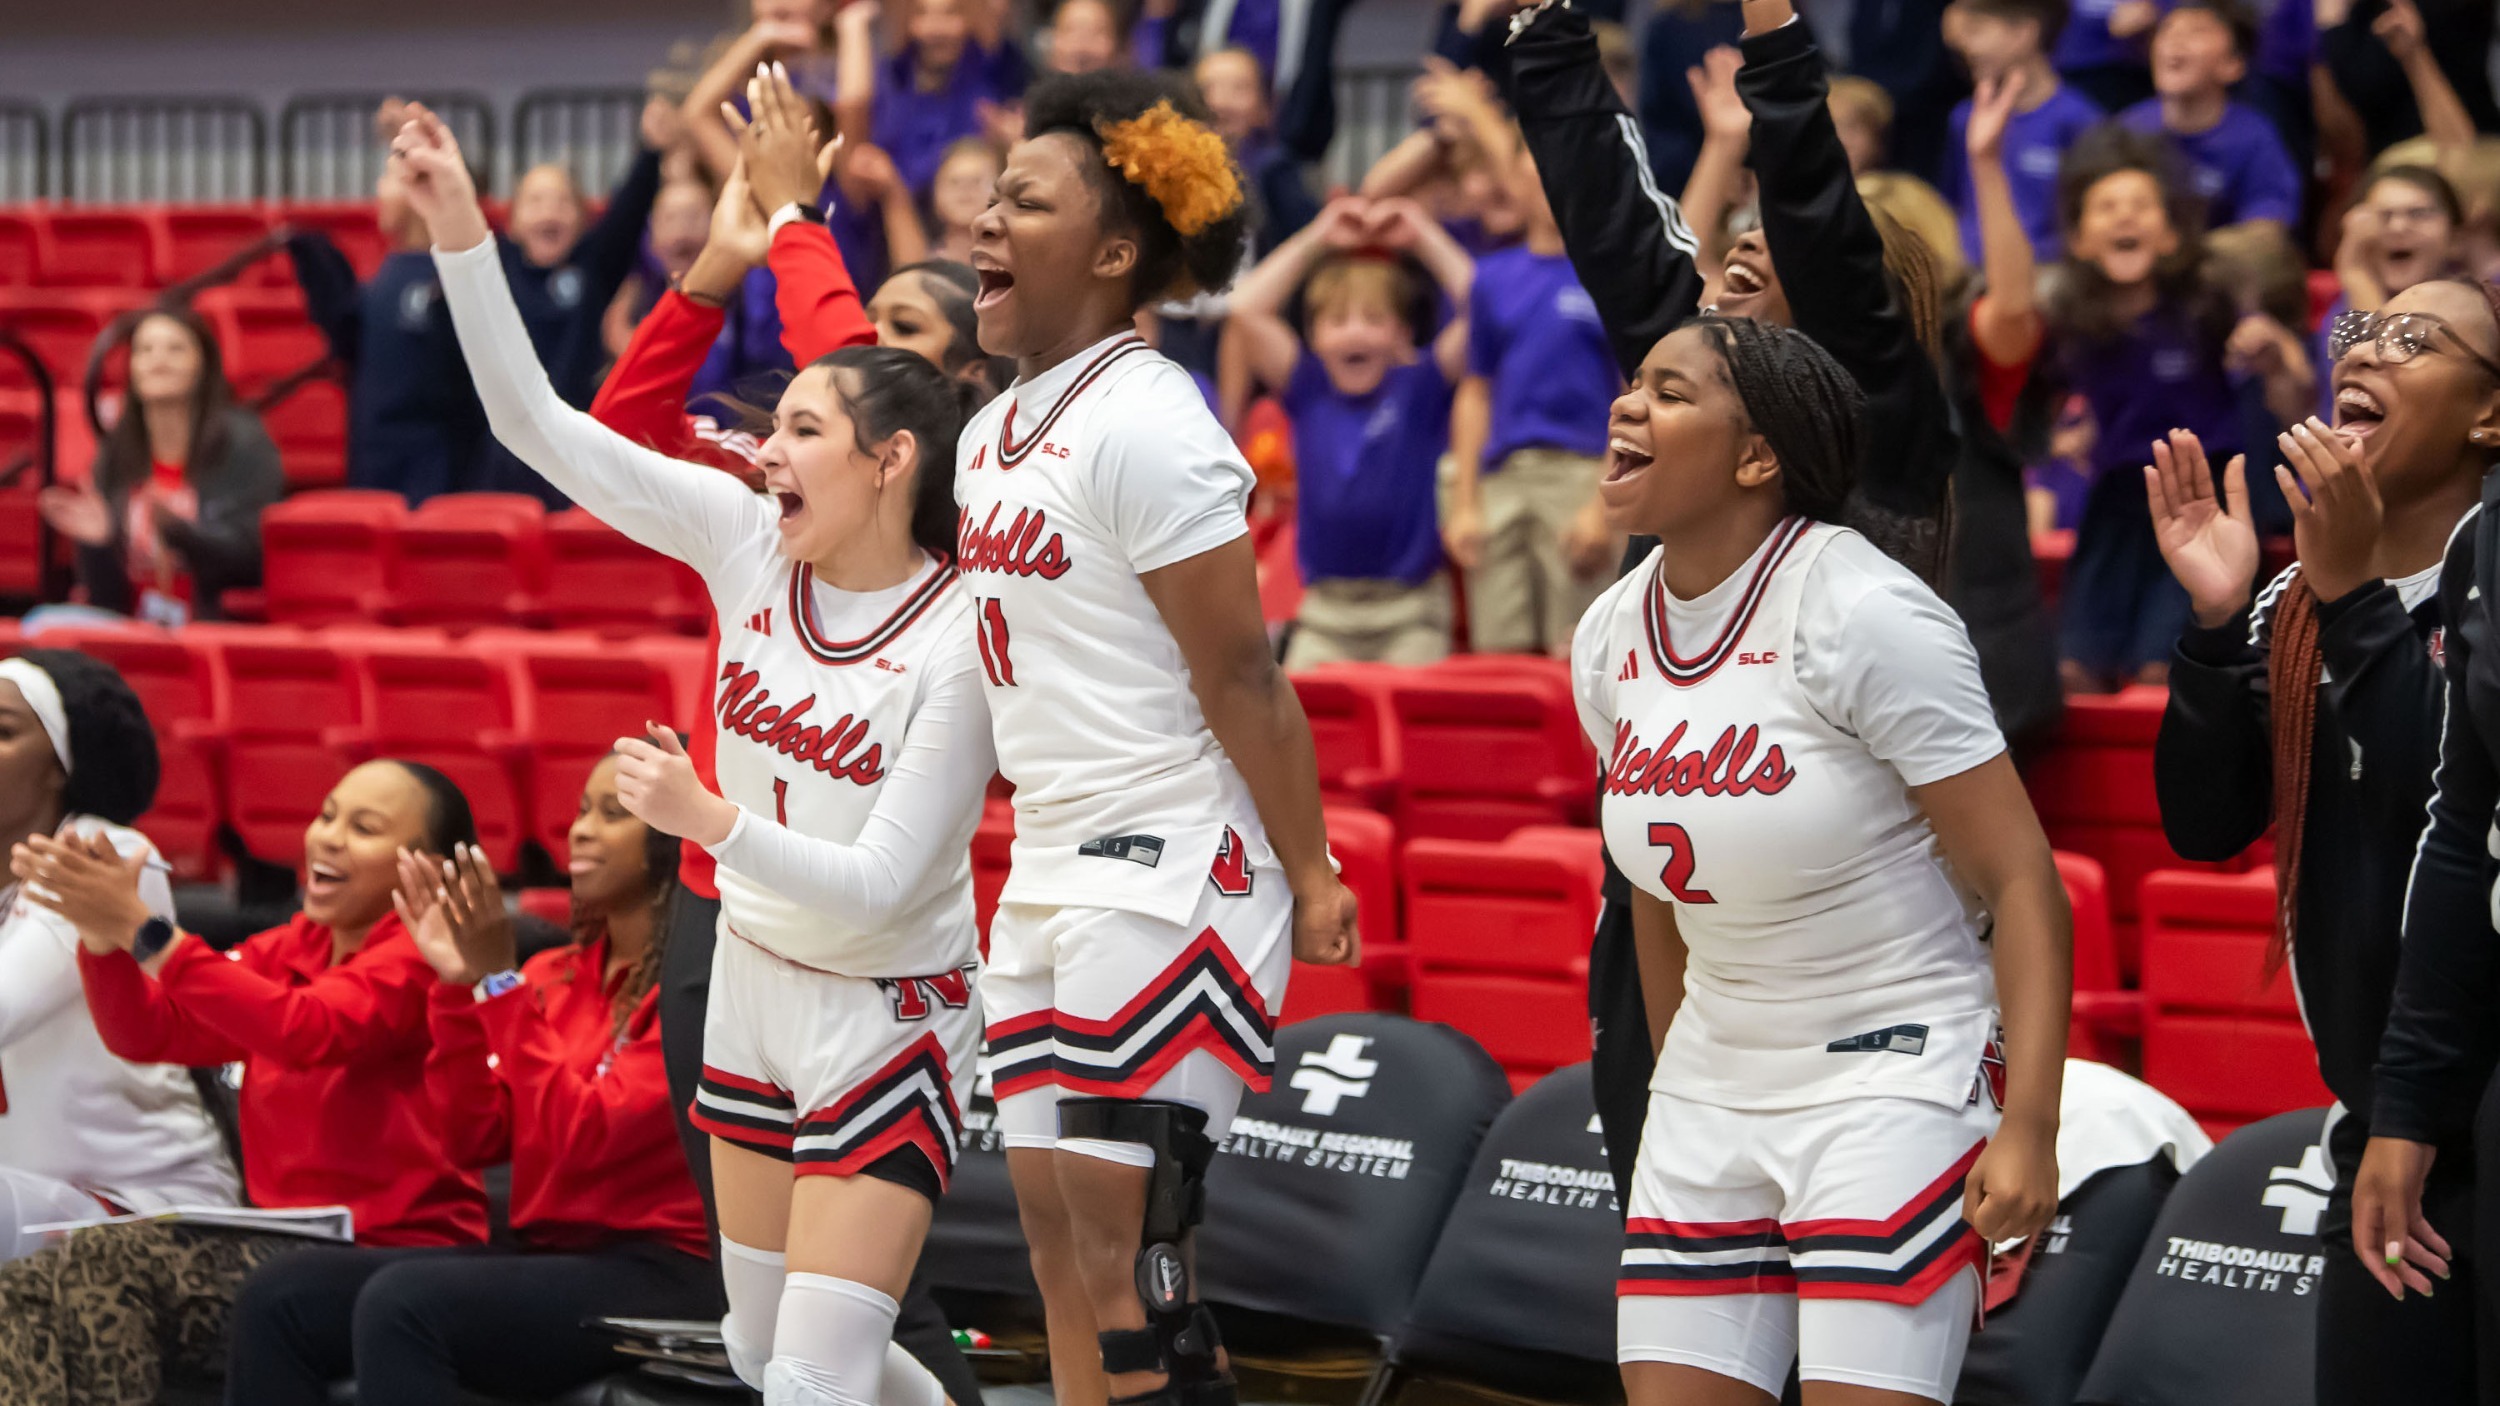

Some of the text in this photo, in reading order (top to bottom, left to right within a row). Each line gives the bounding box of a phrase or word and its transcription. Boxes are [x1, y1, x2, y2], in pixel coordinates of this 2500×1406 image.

[975, 597, 1018, 687] 11
[1737, 651, 1779, 666] SLC
[717, 660, 885, 787] Nicholls
[773, 775, 789, 829] 1
[1648, 822, 1718, 904] 2
[1216, 1134, 1411, 1180] EALTH SYSTEM
[1489, 1178, 1600, 1209] HEALTH
[2156, 1257, 2281, 1292] HEALTH
[2168, 1237, 2303, 1274] THIBODAUX
